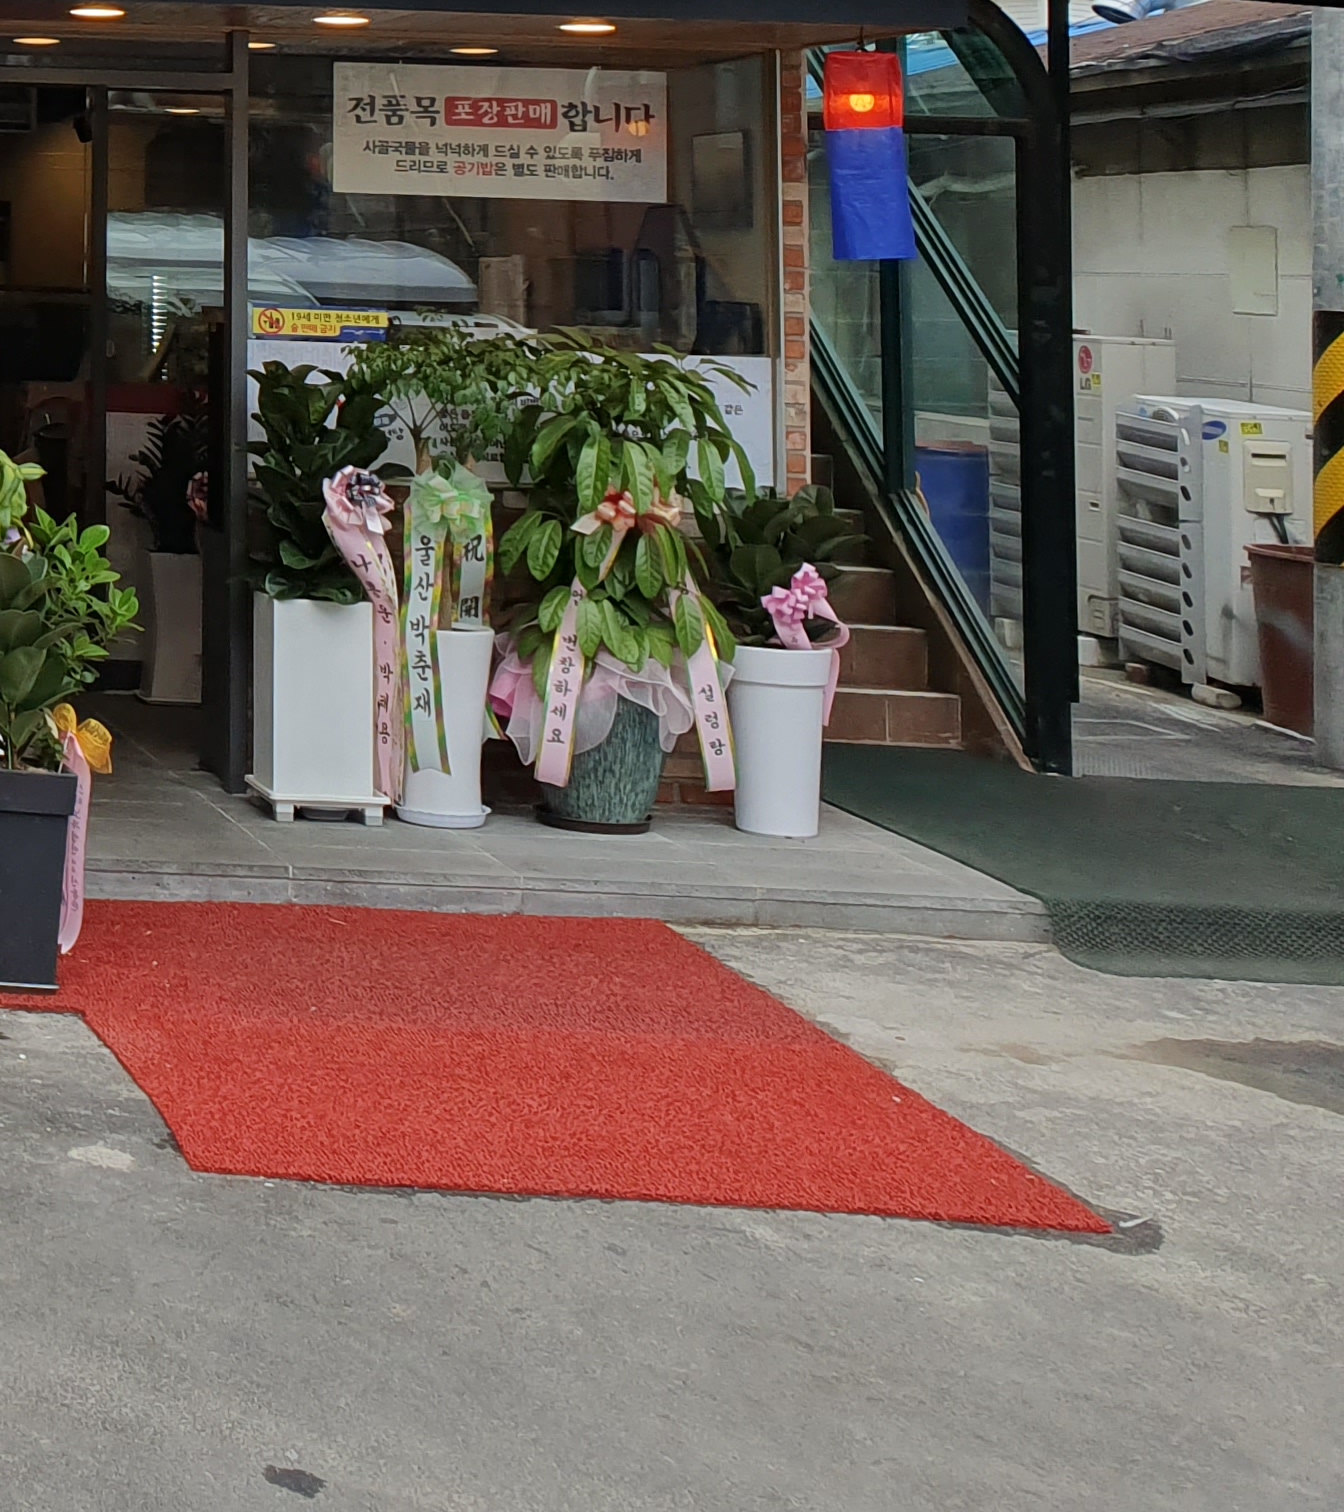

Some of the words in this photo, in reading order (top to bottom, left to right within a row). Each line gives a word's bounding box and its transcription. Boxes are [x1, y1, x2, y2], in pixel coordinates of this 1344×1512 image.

[346, 94, 441, 127] 전품목
[452, 99, 552, 126] 포장판매
[561, 101, 656, 133] 합니다
[363, 140, 431, 156] 사골국물을
[435, 142, 490, 158] 넉넉하게
[493, 144, 521, 158] 드실
[524, 145, 540, 160] 수
[543, 145, 584, 161] 있도록
[588, 147, 642, 164] 푸짐하게
[394, 159, 450, 174] 드리므로
[453, 161, 508, 177] 공기밥은
[512, 163, 540, 178] 별도
[543, 164, 615, 181] 판매합니다.
[413, 535, 436, 602] 울산
